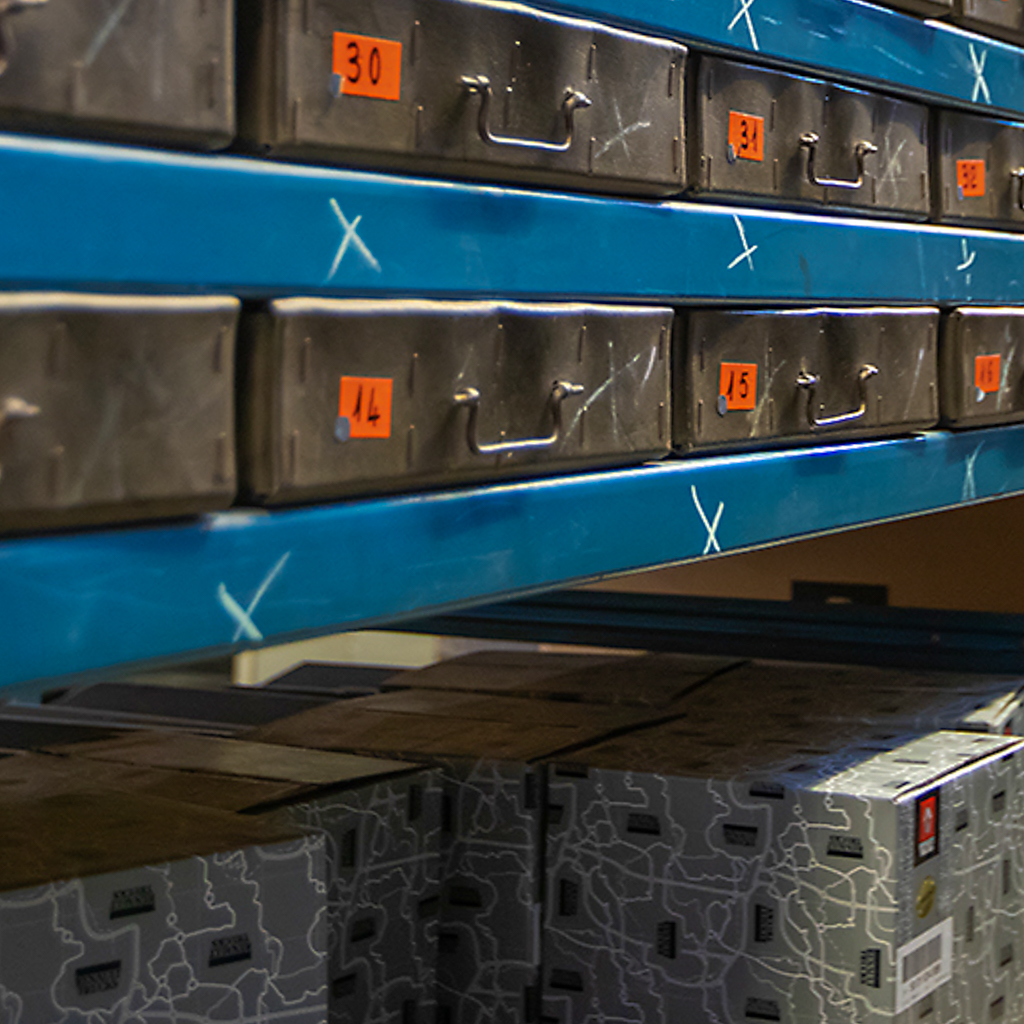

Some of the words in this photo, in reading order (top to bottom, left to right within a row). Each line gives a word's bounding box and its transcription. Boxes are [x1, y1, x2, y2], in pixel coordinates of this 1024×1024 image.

[347, 41, 381, 85] 30
[740, 119, 758, 153] 31
[352, 383, 381, 427] 14
[726, 370, 749, 401] 15
